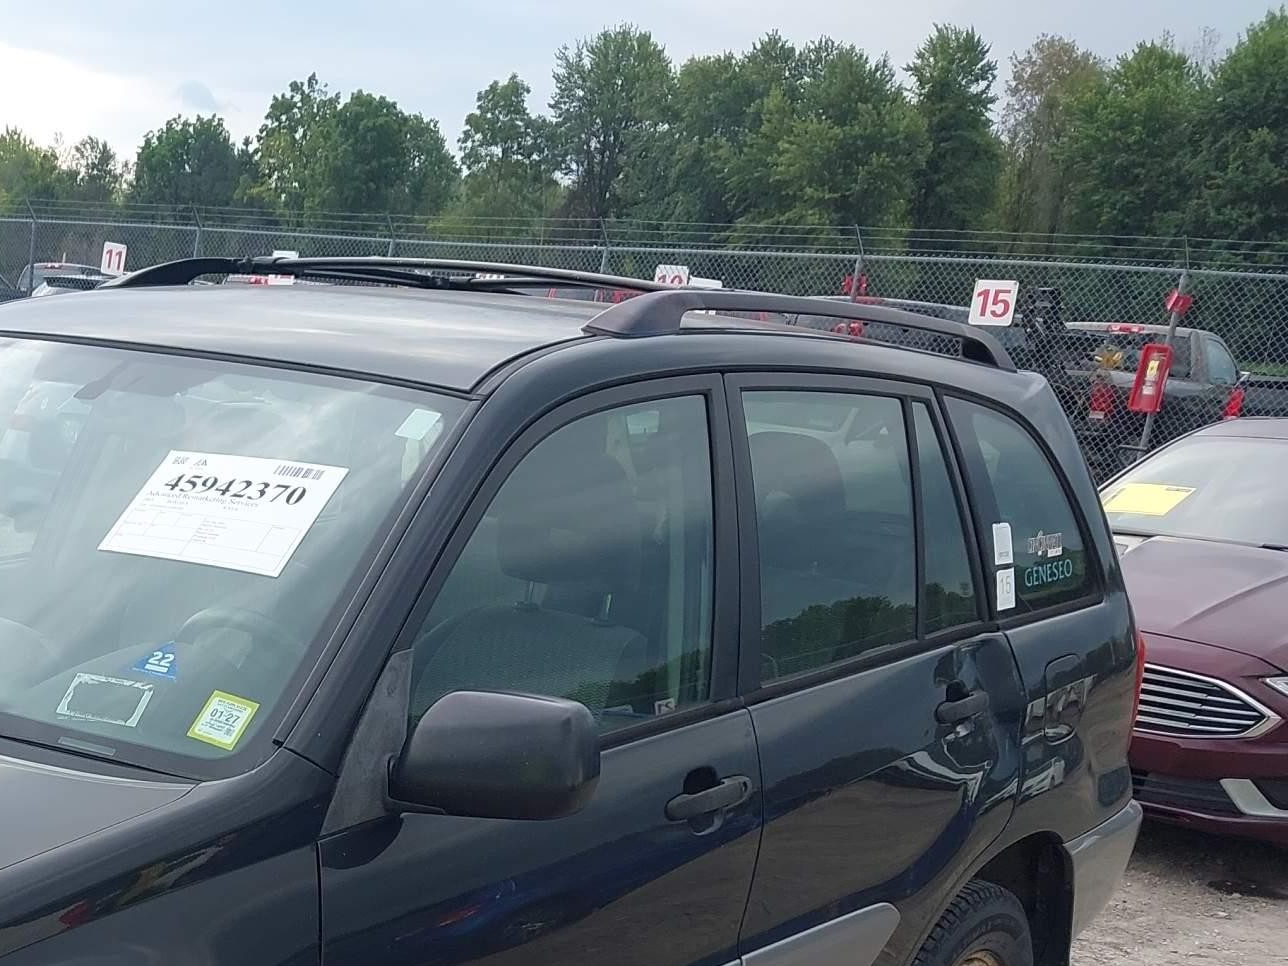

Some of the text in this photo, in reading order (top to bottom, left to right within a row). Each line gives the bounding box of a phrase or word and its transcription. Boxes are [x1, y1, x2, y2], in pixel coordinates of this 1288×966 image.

[105, 248, 124, 271] 11
[977, 288, 1011, 318] 15
[164, 473, 307, 506] 45942370
[1024, 558, 1073, 587] GENESEO
[148, 650, 175, 668] 22
